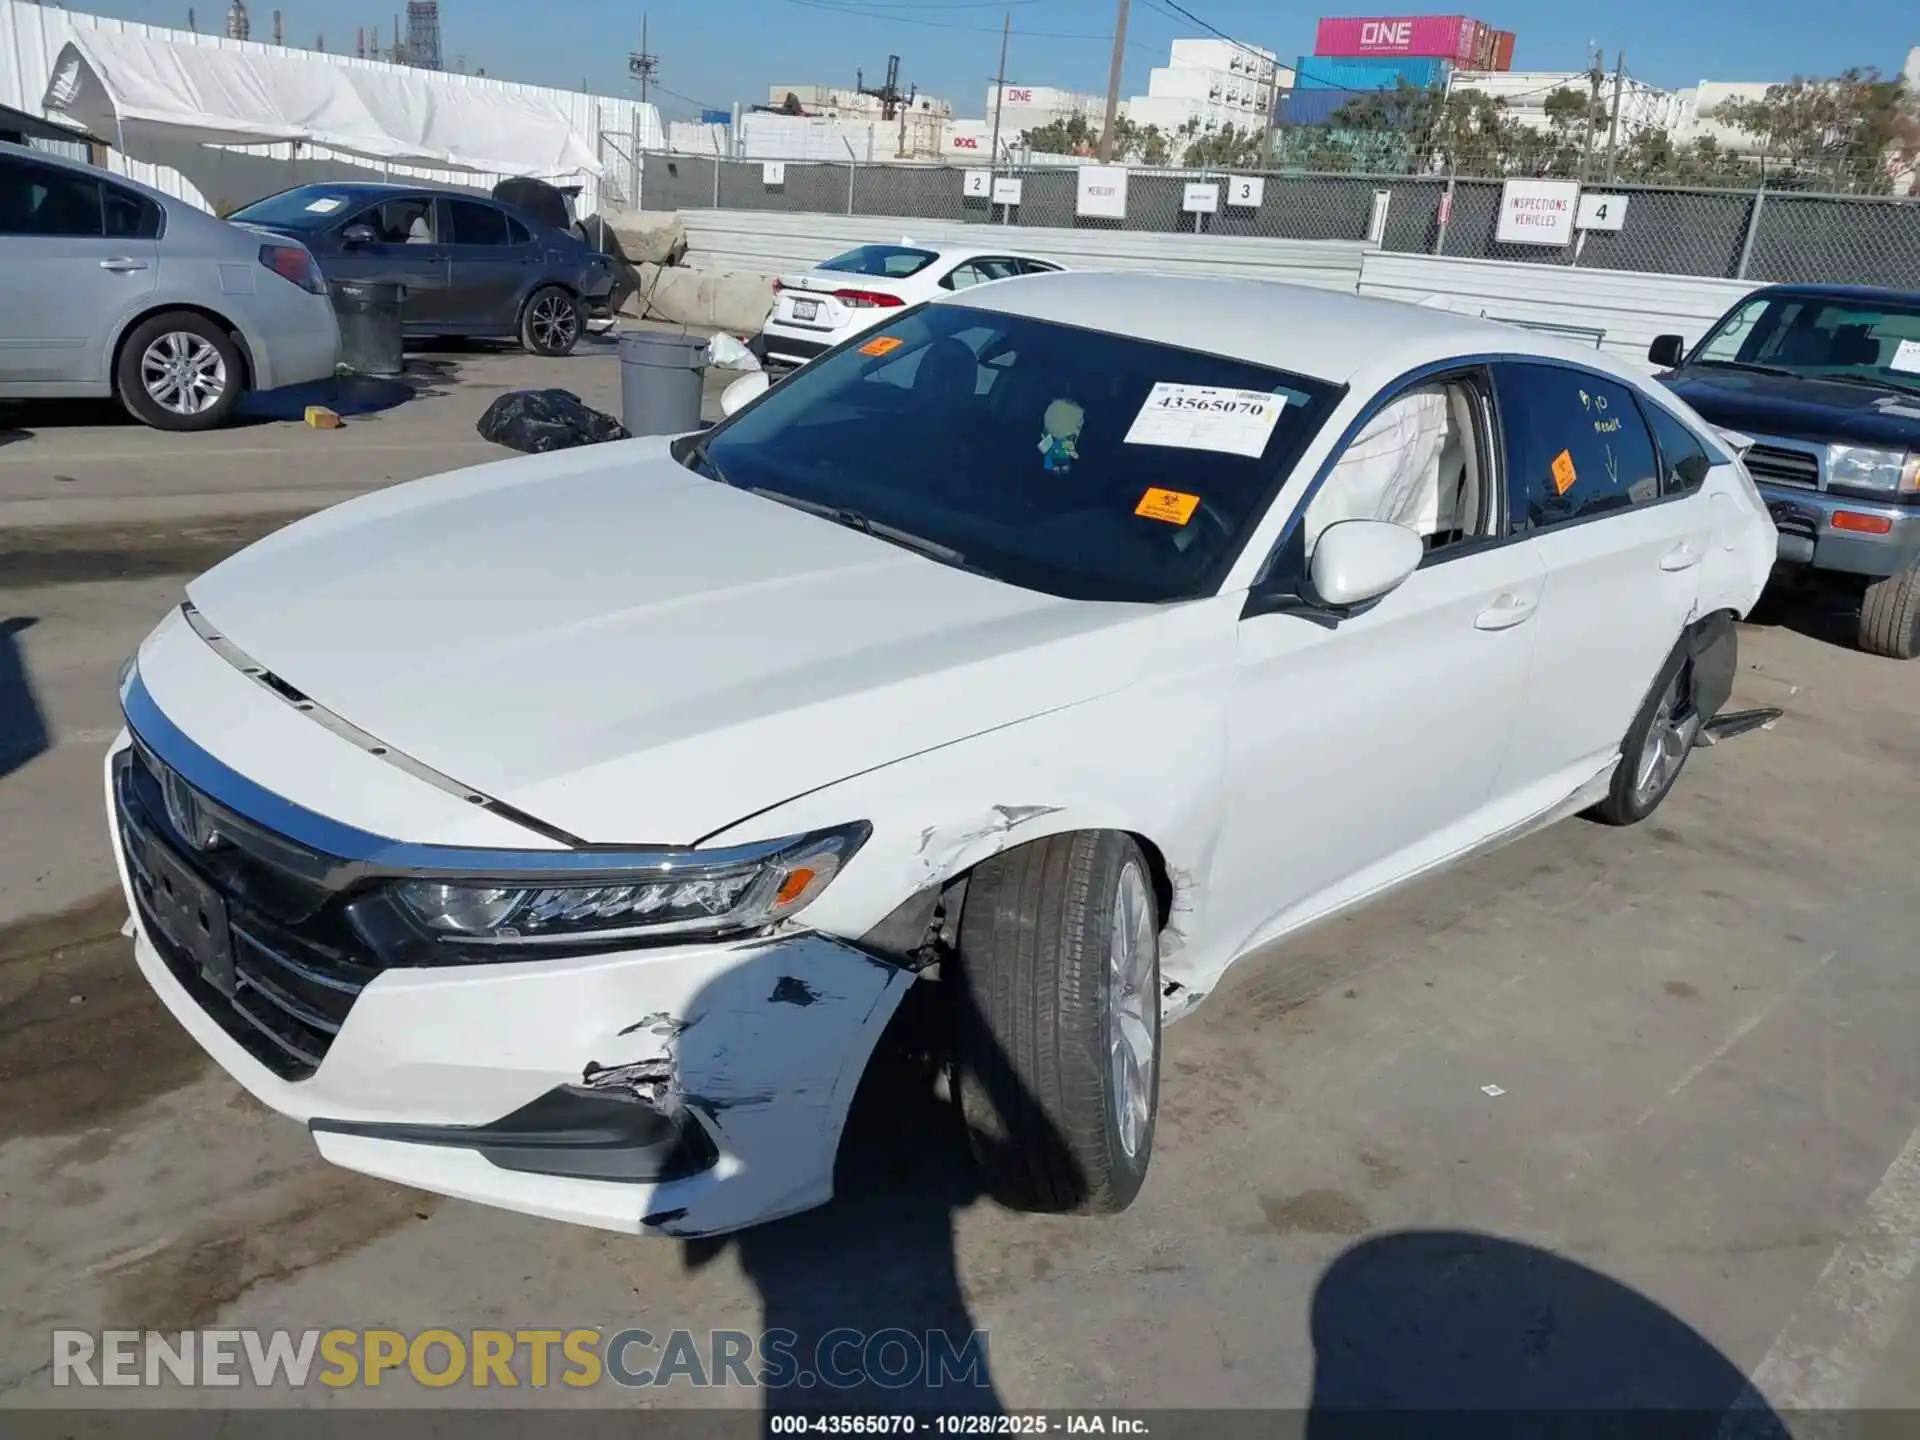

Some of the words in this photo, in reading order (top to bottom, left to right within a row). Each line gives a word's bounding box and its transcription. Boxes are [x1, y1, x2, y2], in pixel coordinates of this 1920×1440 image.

[1360, 21, 1412, 44] ONE
[1008, 90, 1032, 101] ONE
[772, 167, 777, 178] 1
[973, 177, 981, 190] 2
[1241, 184, 1250, 199] 3
[1510, 197, 1568, 212] INSPECTIONS
[1595, 204, 1608, 221] 4
[1515, 214, 1557, 227] VEHICLES
[1158, 396, 1264, 416] 43565070
